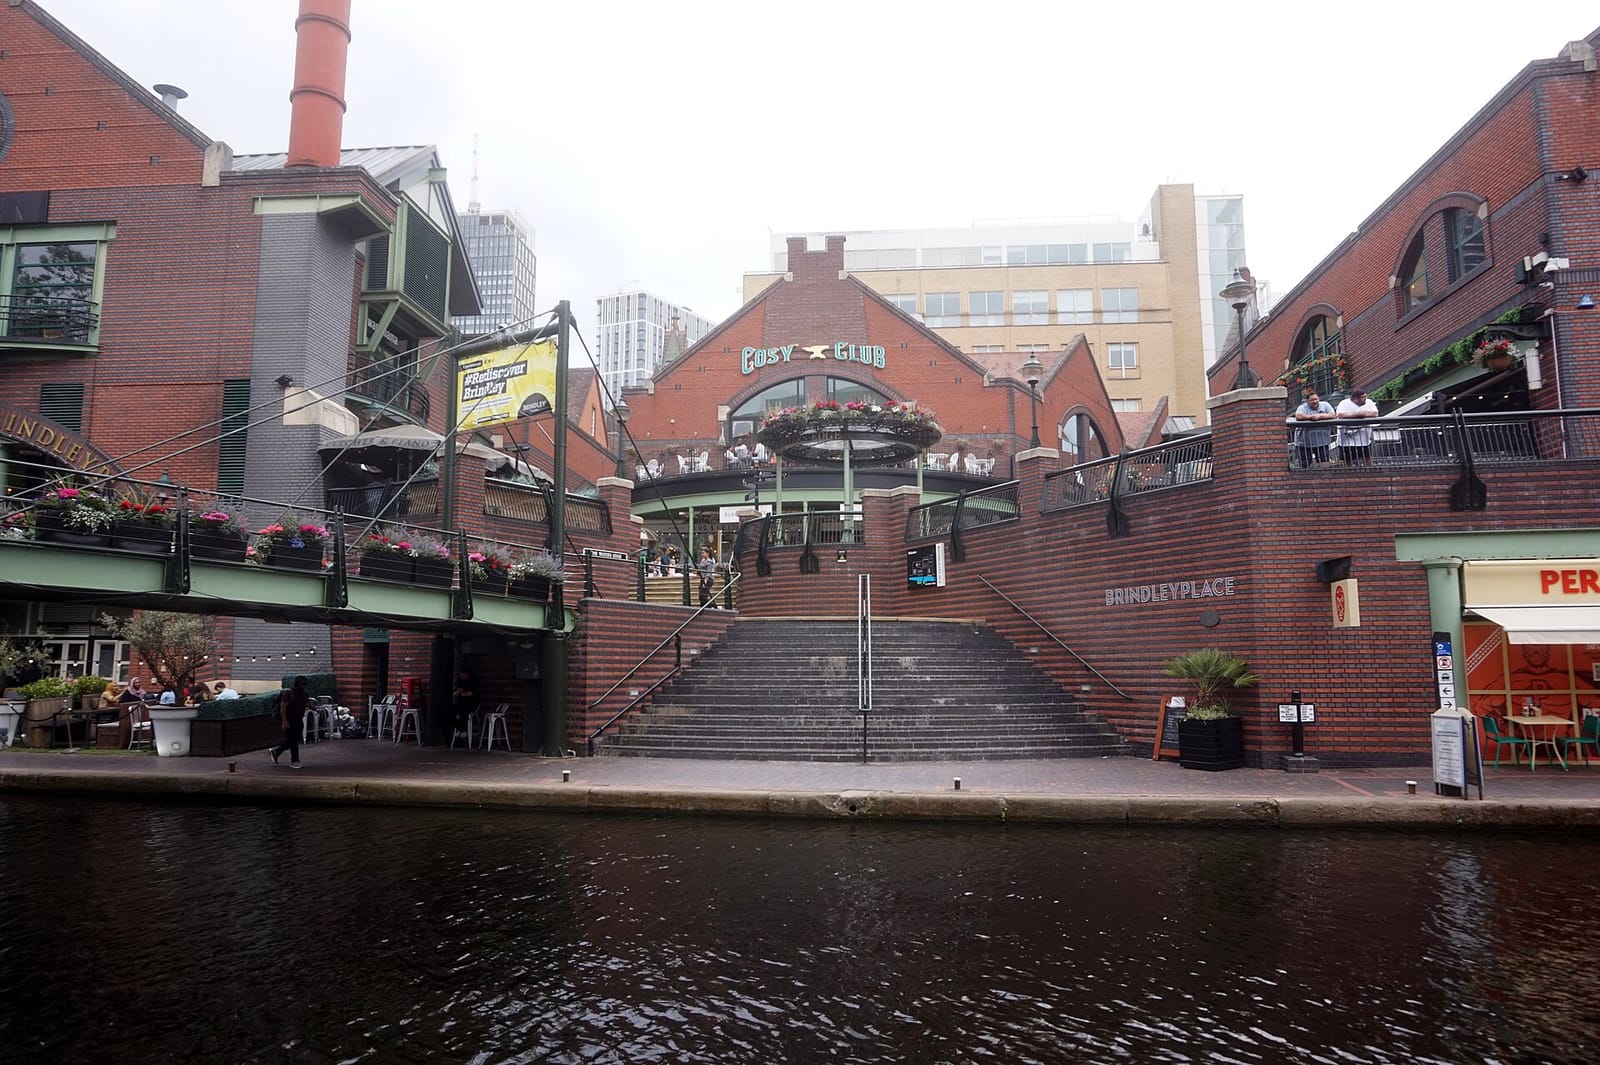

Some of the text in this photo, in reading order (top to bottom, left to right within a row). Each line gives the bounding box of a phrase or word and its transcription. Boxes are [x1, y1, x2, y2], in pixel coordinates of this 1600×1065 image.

[741, 341, 886, 375] COSY CLUB
[464, 363, 526, 386] #Rediscover
[463, 381, 506, 400] Brindley
[1105, 576, 1235, 606] BRINDLEYPLACE
[1540, 569, 1600, 595] PER
